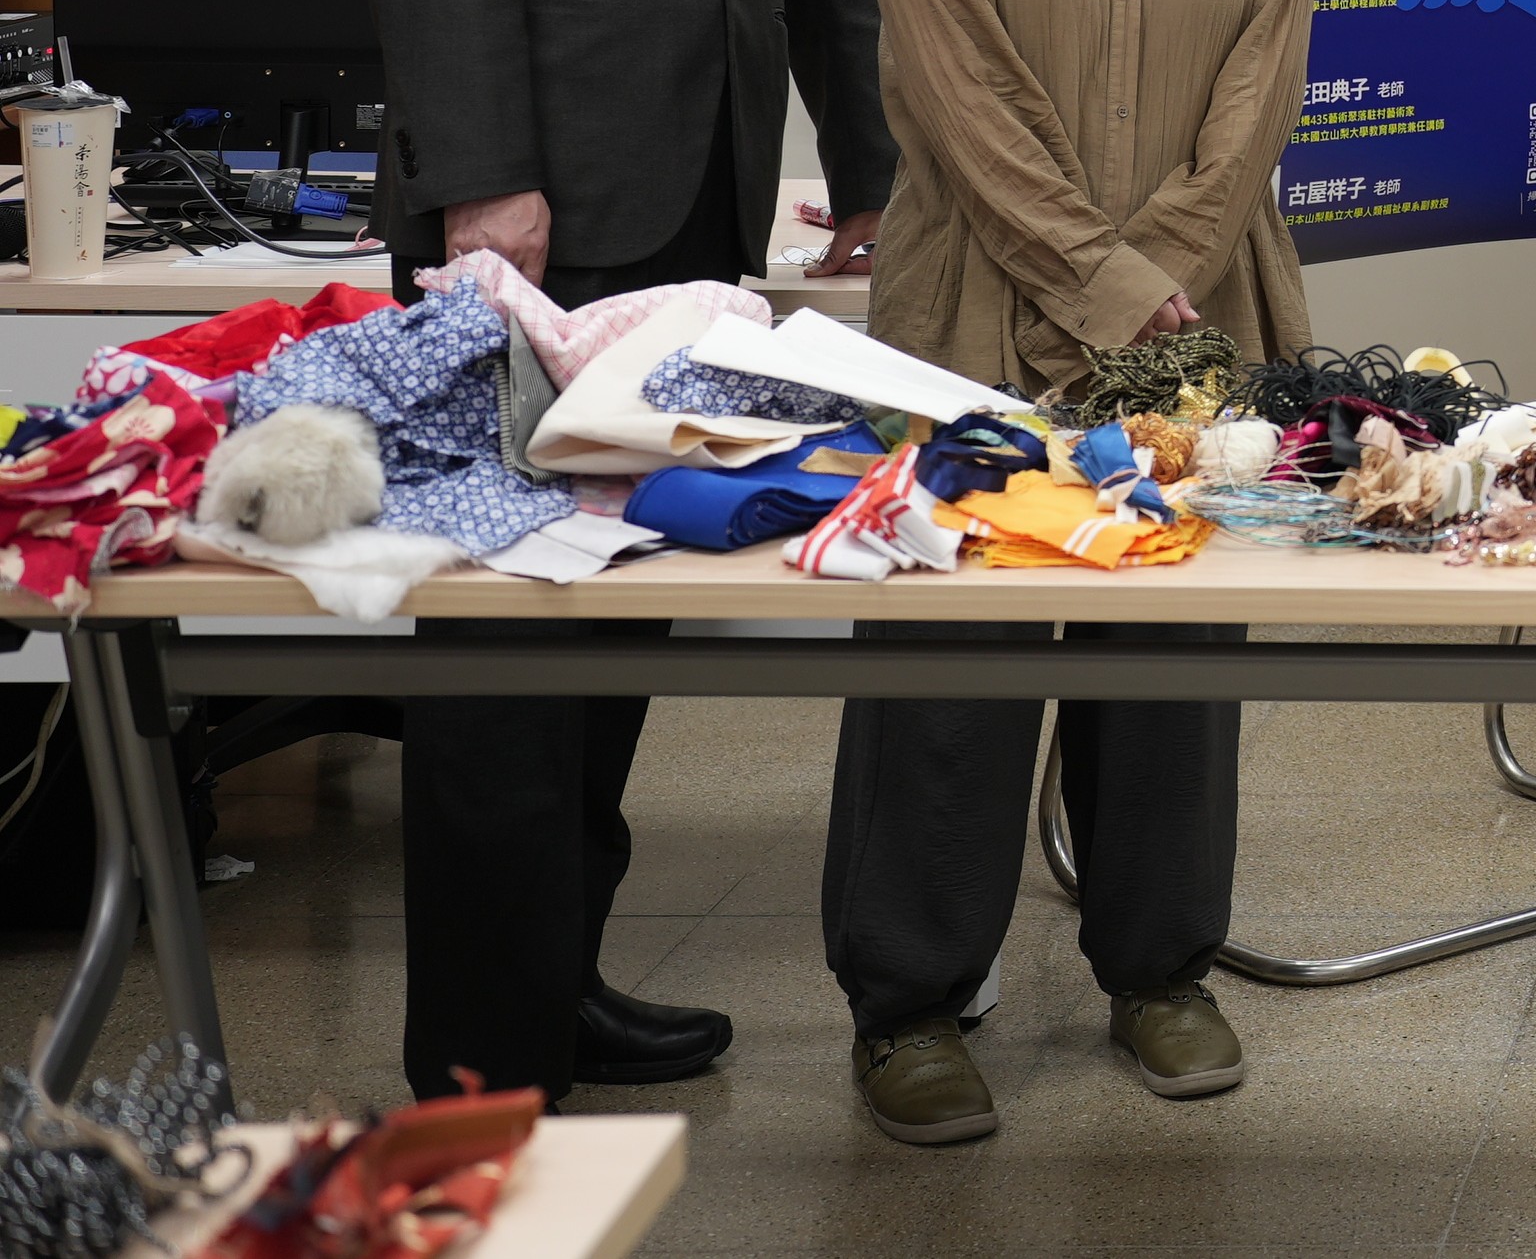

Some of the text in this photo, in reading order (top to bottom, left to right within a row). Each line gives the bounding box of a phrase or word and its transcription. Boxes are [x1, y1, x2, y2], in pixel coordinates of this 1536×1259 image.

[1377, 80, 1405, 99] 老師
[1290, 118, 1445, 145] 日本國立山梨大學教育學院兼任講師
[1287, 177, 1401, 207] 古屋祥子 老師
